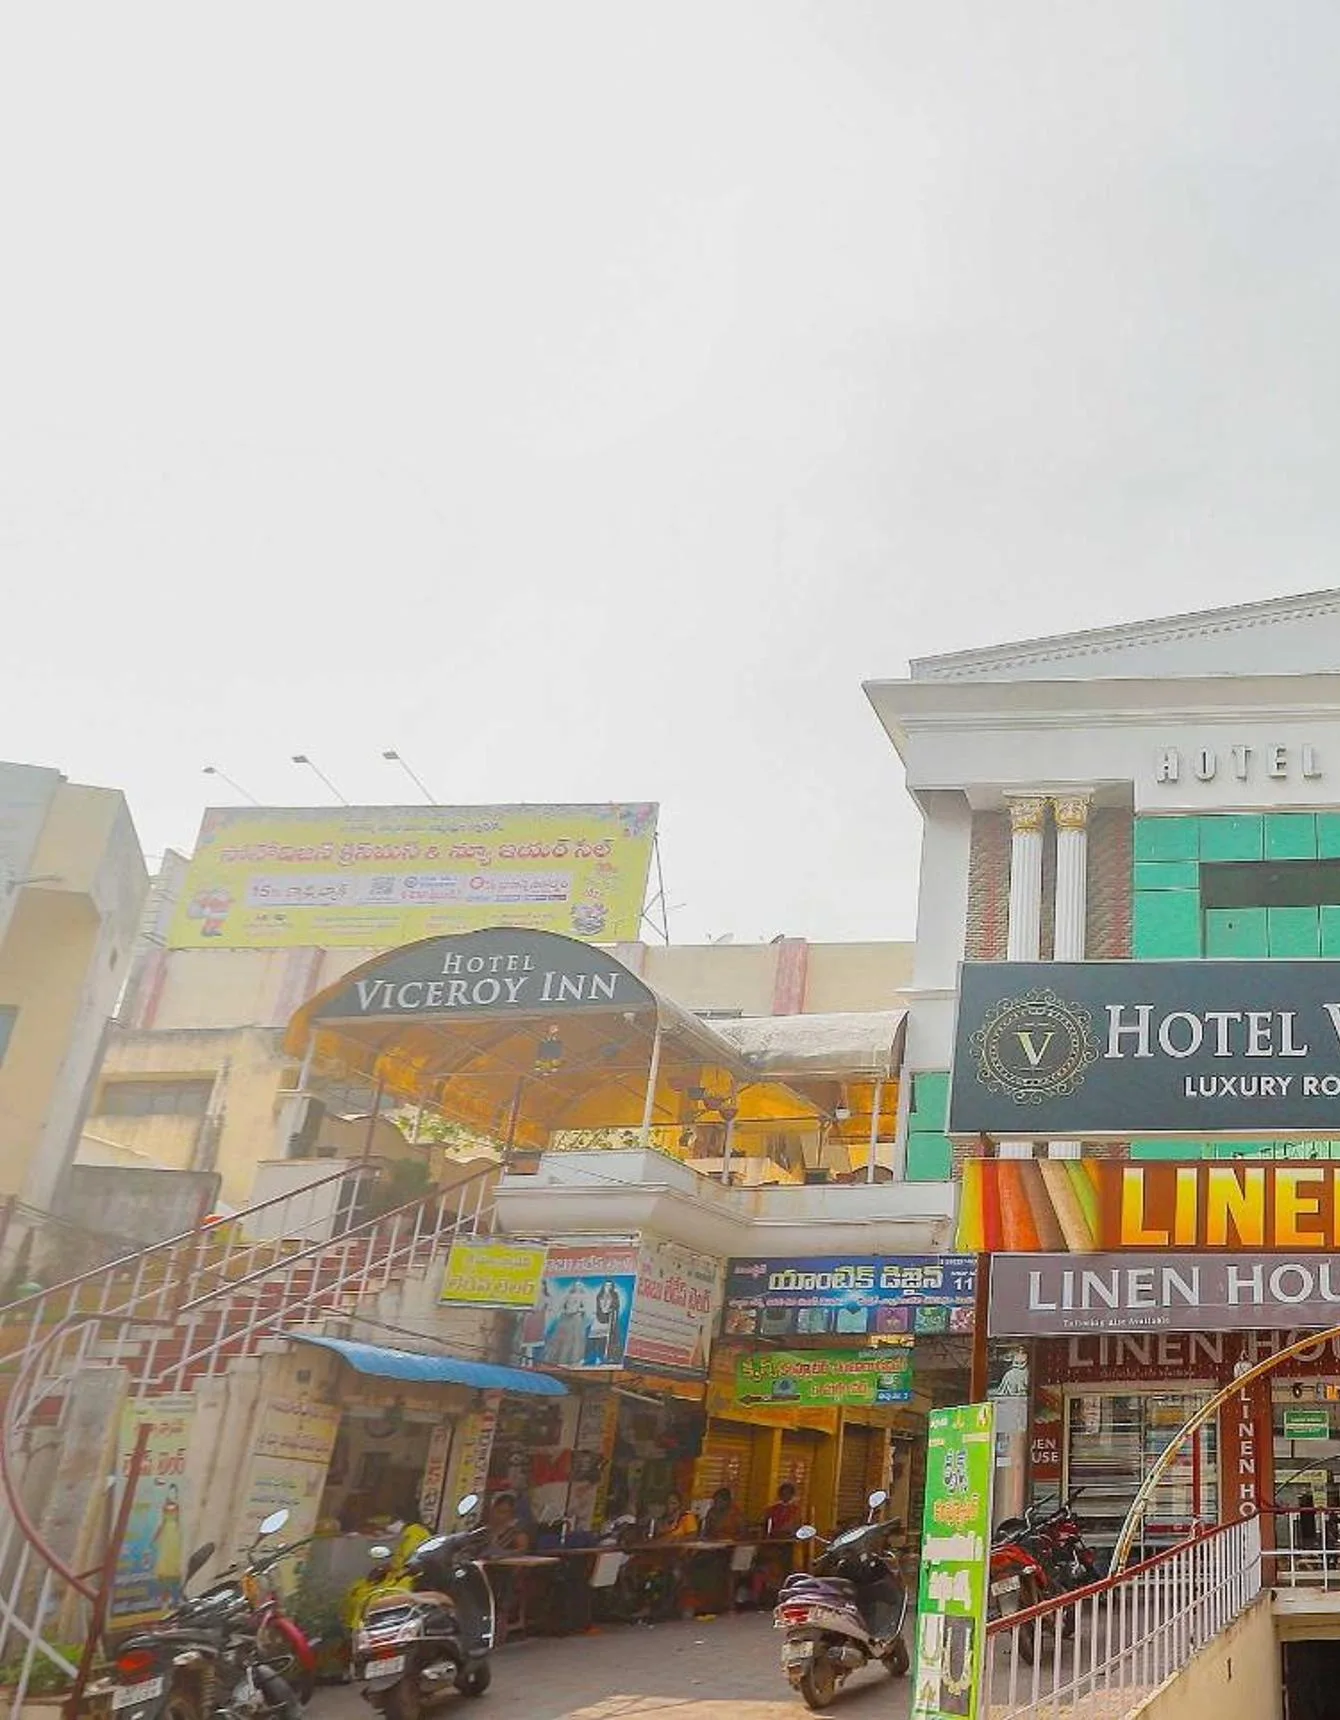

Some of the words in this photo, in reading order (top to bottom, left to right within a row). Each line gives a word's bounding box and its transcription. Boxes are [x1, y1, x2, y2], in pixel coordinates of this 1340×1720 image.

[1156, 743, 1322, 783] HOTEL
[441, 950, 535, 975] HOTEL
[354, 977, 531, 1011] VICEROY
[540, 970, 621, 1002] INN
[1103, 1004, 1308, 1058] HOTEL
[1185, 1075, 1293, 1098] LUXURY
[1029, 1266, 1200, 1310] LINEN
[1068, 1332, 1224, 1367] LINEN
